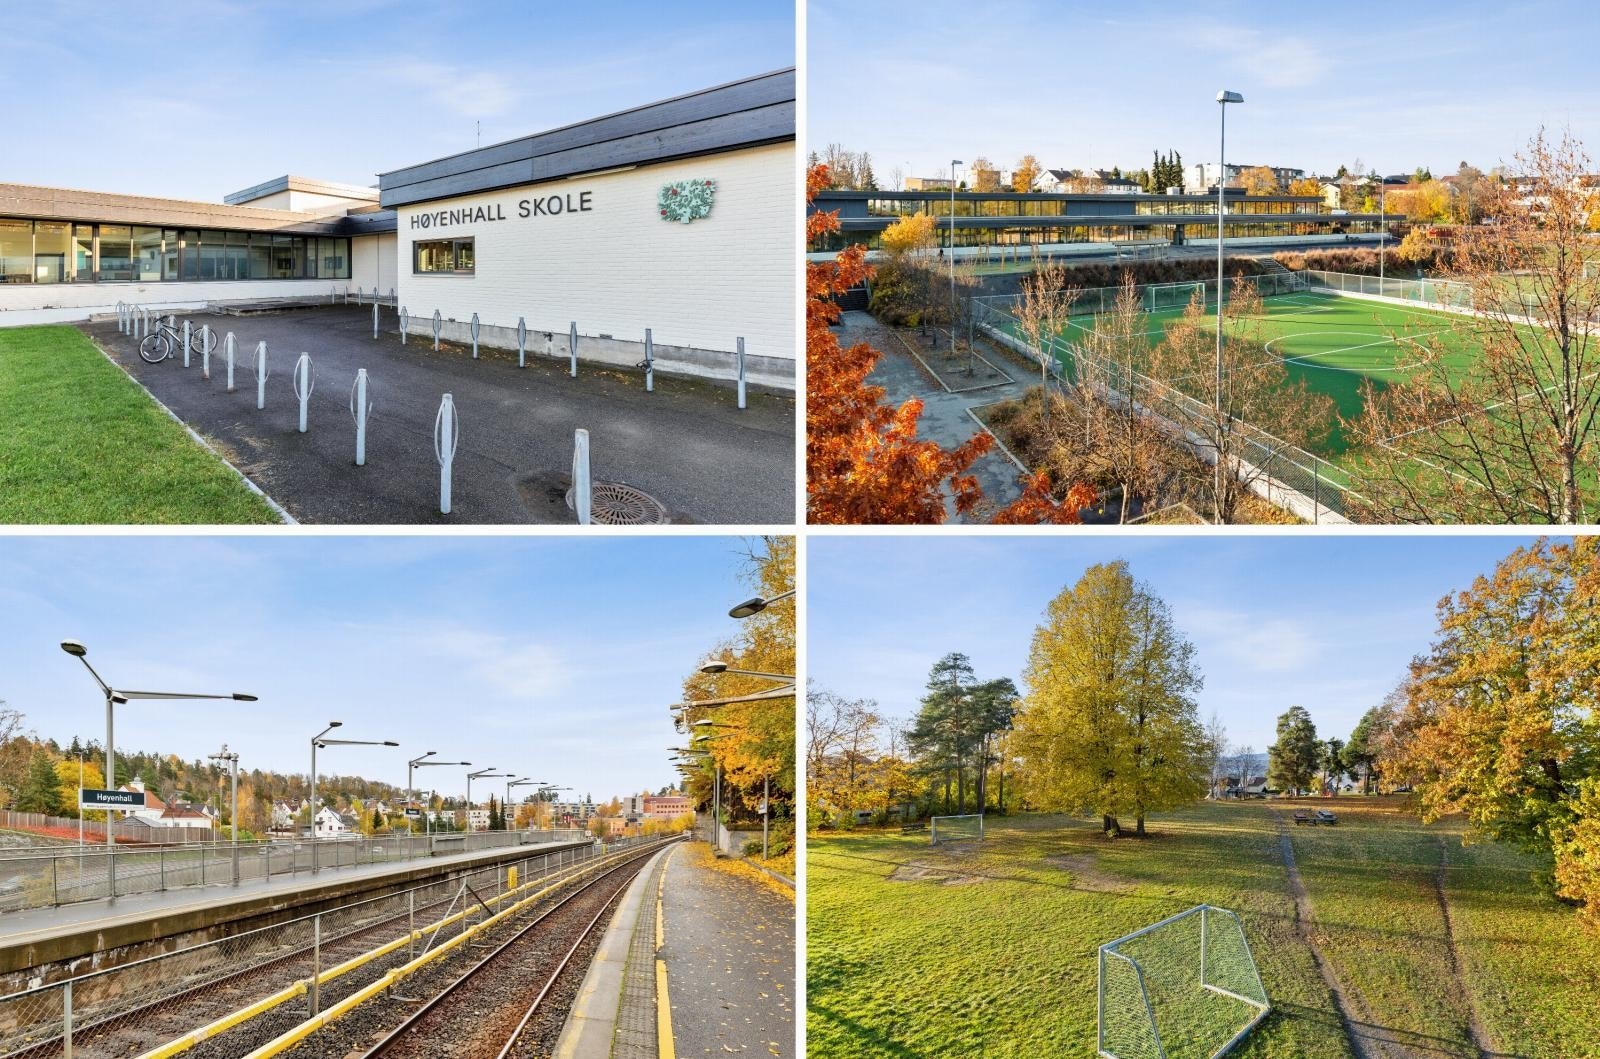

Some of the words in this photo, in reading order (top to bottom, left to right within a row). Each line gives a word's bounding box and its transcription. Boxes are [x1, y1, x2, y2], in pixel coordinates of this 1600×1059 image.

[410, 204, 506, 229] HØYENHALL
[519, 191, 593, 218] SKOLE
[97, 793, 133, 803] Høyenhall
